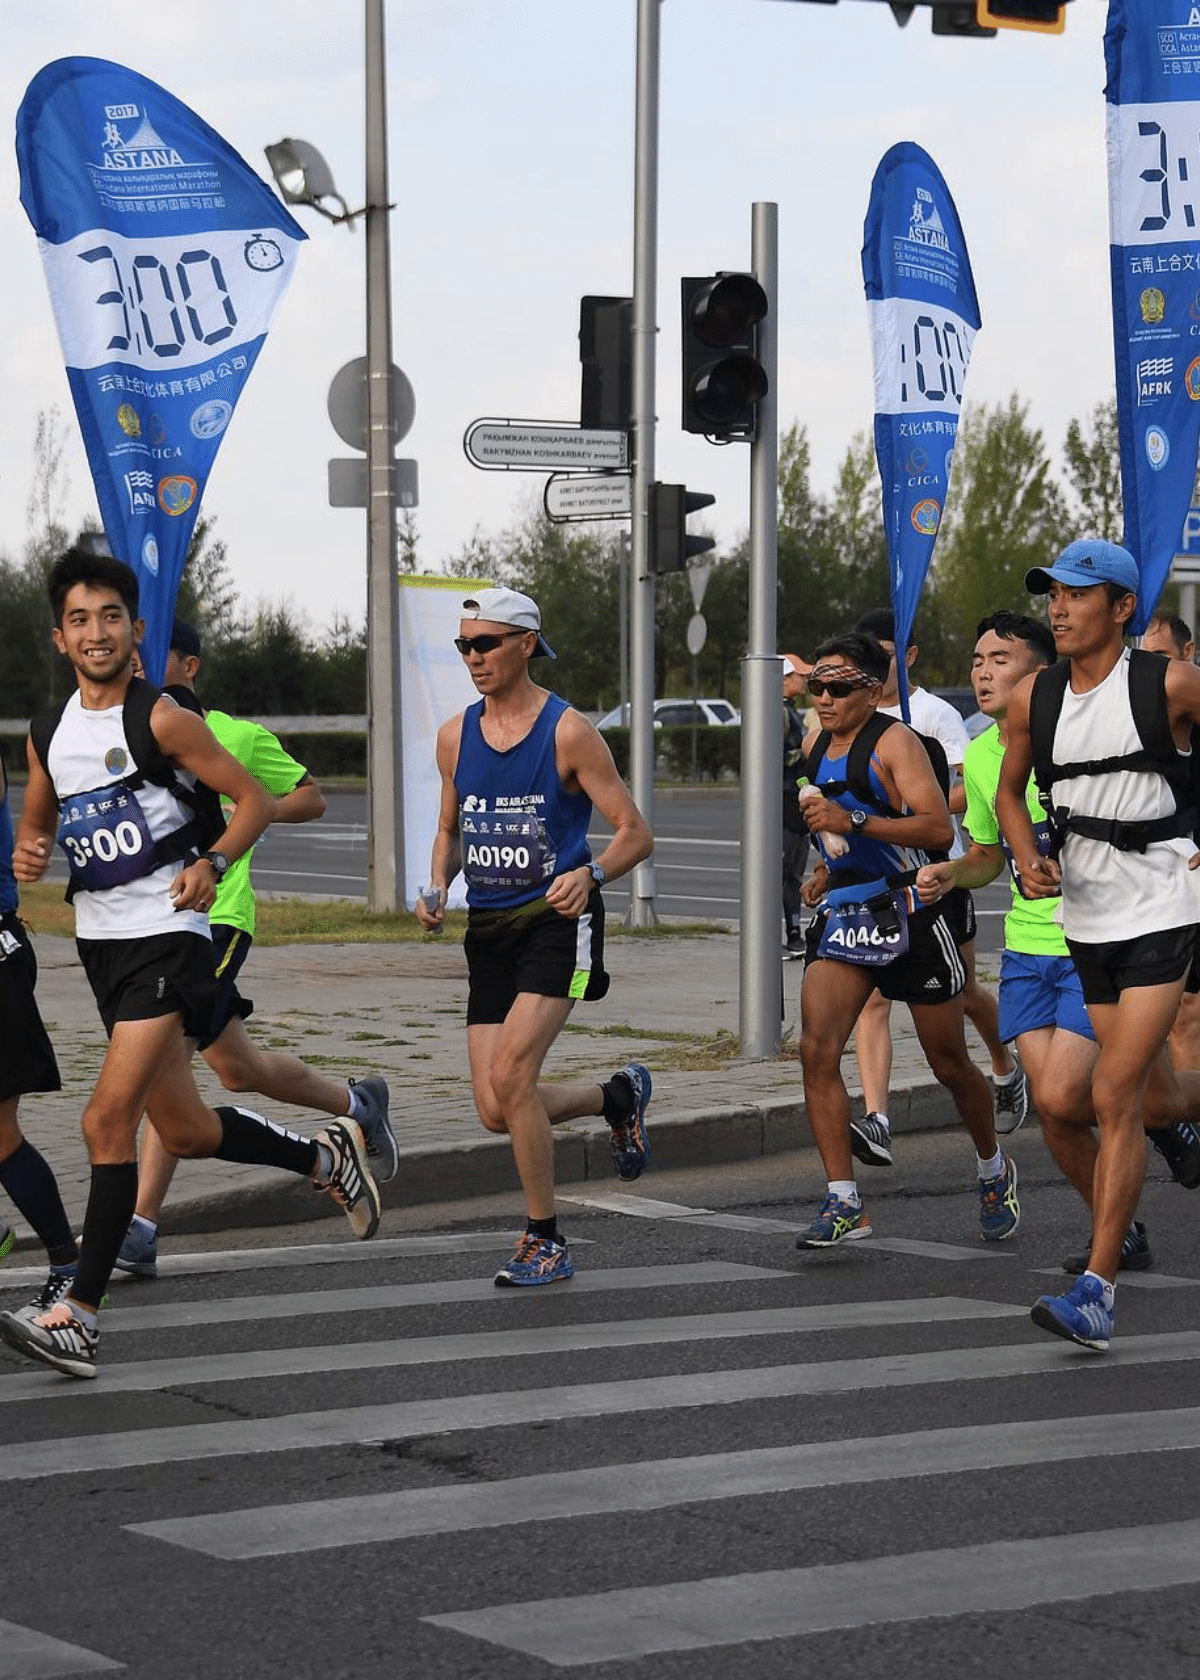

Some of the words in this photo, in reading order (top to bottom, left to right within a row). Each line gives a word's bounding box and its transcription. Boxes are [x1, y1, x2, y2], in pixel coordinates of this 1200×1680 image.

[108, 106, 135, 117] 2017
[104, 149, 185, 168] ASTANA
[126, 182, 177, 193] International
[178, 180, 222, 190] Marathon
[909, 226, 950, 251] ASTANA
[77, 245, 237, 357] 3:00
[1141, 381, 1172, 396] AFRK
[483, 447, 532, 456] RAKYMZHAN
[534, 449, 592, 459] KOSHKARBAEV
[908, 475, 939, 487] CICA
[65, 820, 143, 868] 3:00
[467, 844, 529, 869] A0190
